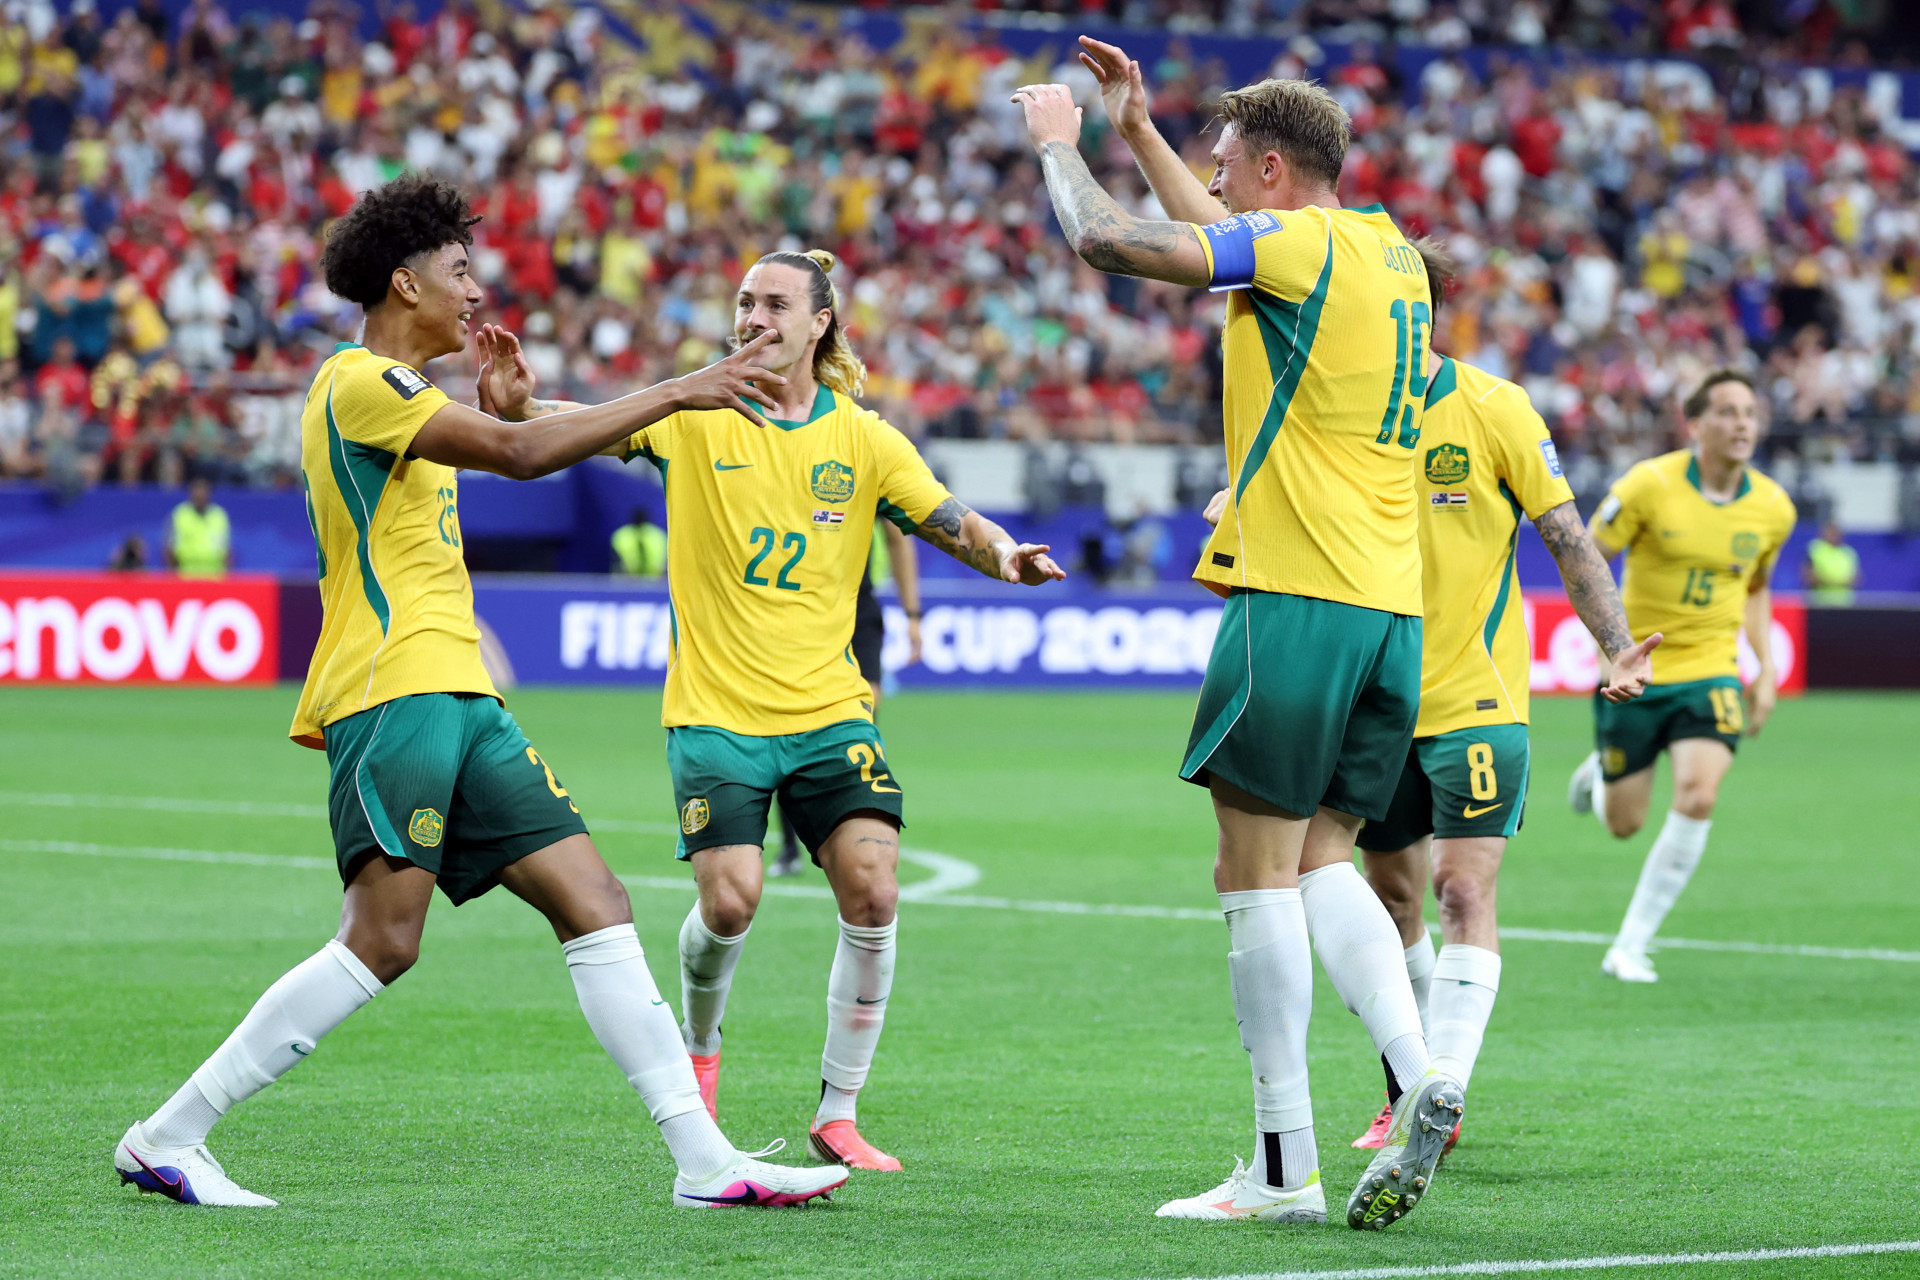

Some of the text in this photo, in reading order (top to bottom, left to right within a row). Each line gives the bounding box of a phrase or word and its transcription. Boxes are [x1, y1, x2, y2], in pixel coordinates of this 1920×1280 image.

[1376, 299, 1430, 449] 19
[437, 487, 459, 548] 25
[743, 527, 806, 591] 22
[1680, 567, 1715, 606] 15
[0, 597, 264, 682] novo
[921, 606, 1040, 674] CUP
[1709, 687, 1743, 734] 15
[1467, 742, 1498, 801] 8
